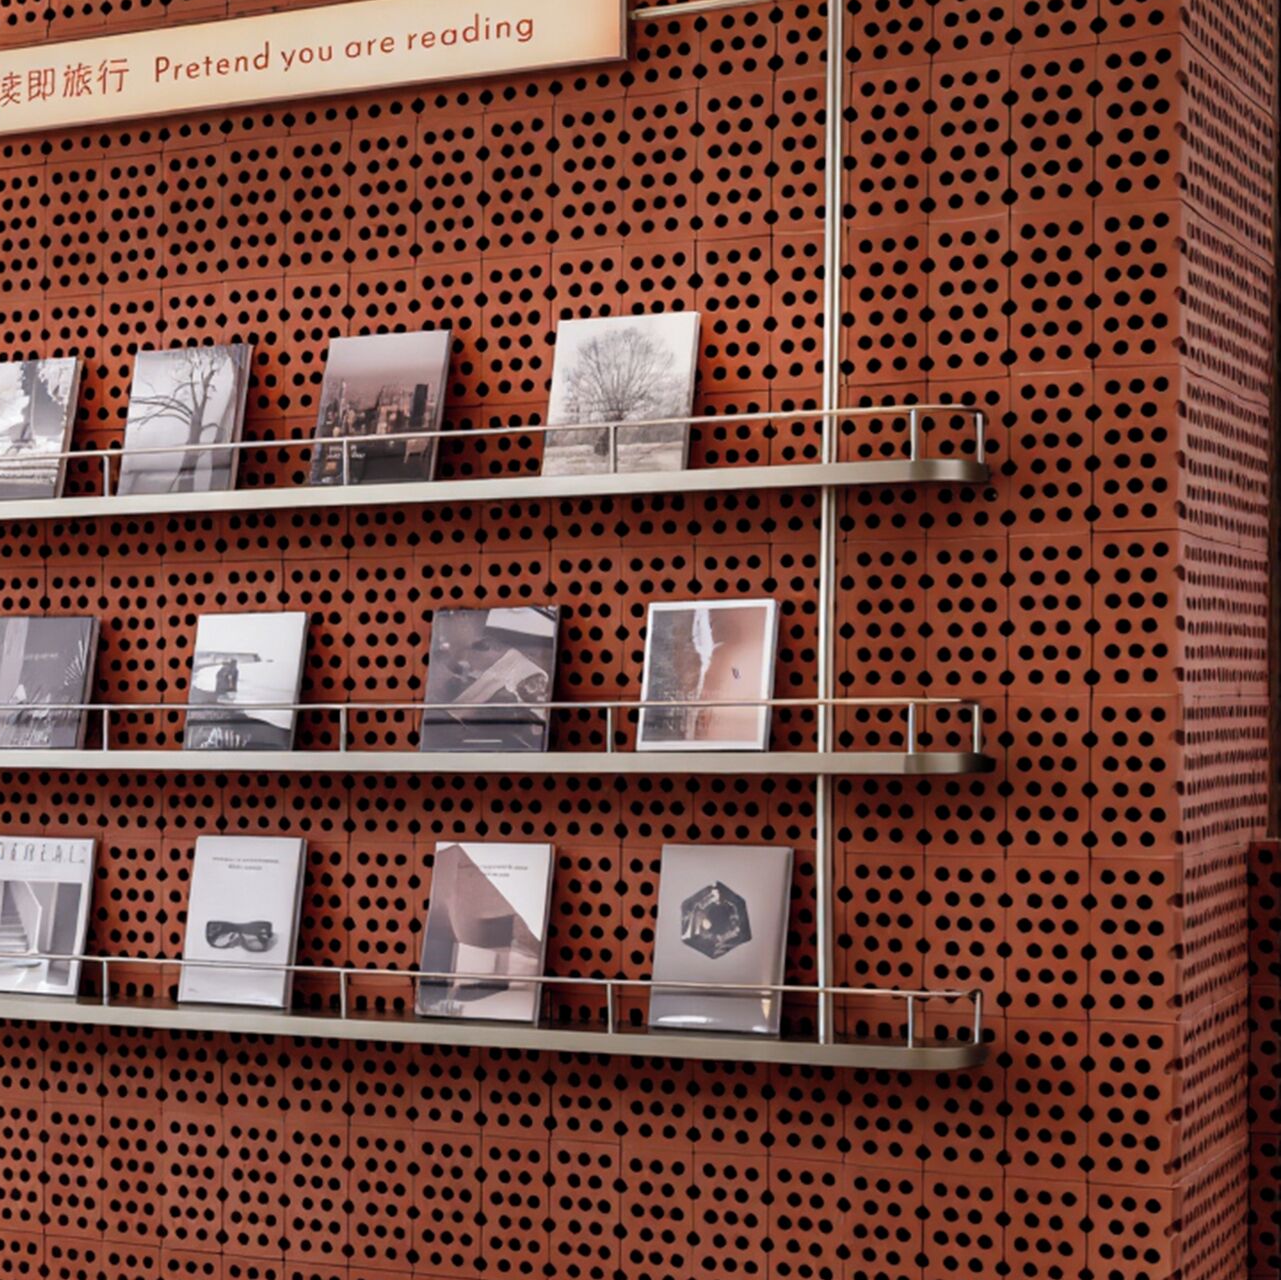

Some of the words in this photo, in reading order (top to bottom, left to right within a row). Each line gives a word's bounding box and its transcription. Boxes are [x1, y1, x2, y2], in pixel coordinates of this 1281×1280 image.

[154, 41, 270, 83] Pretend
[280, 45, 334, 72] you
[344, 36, 396, 59] are
[407, 13, 535, 50] reading
